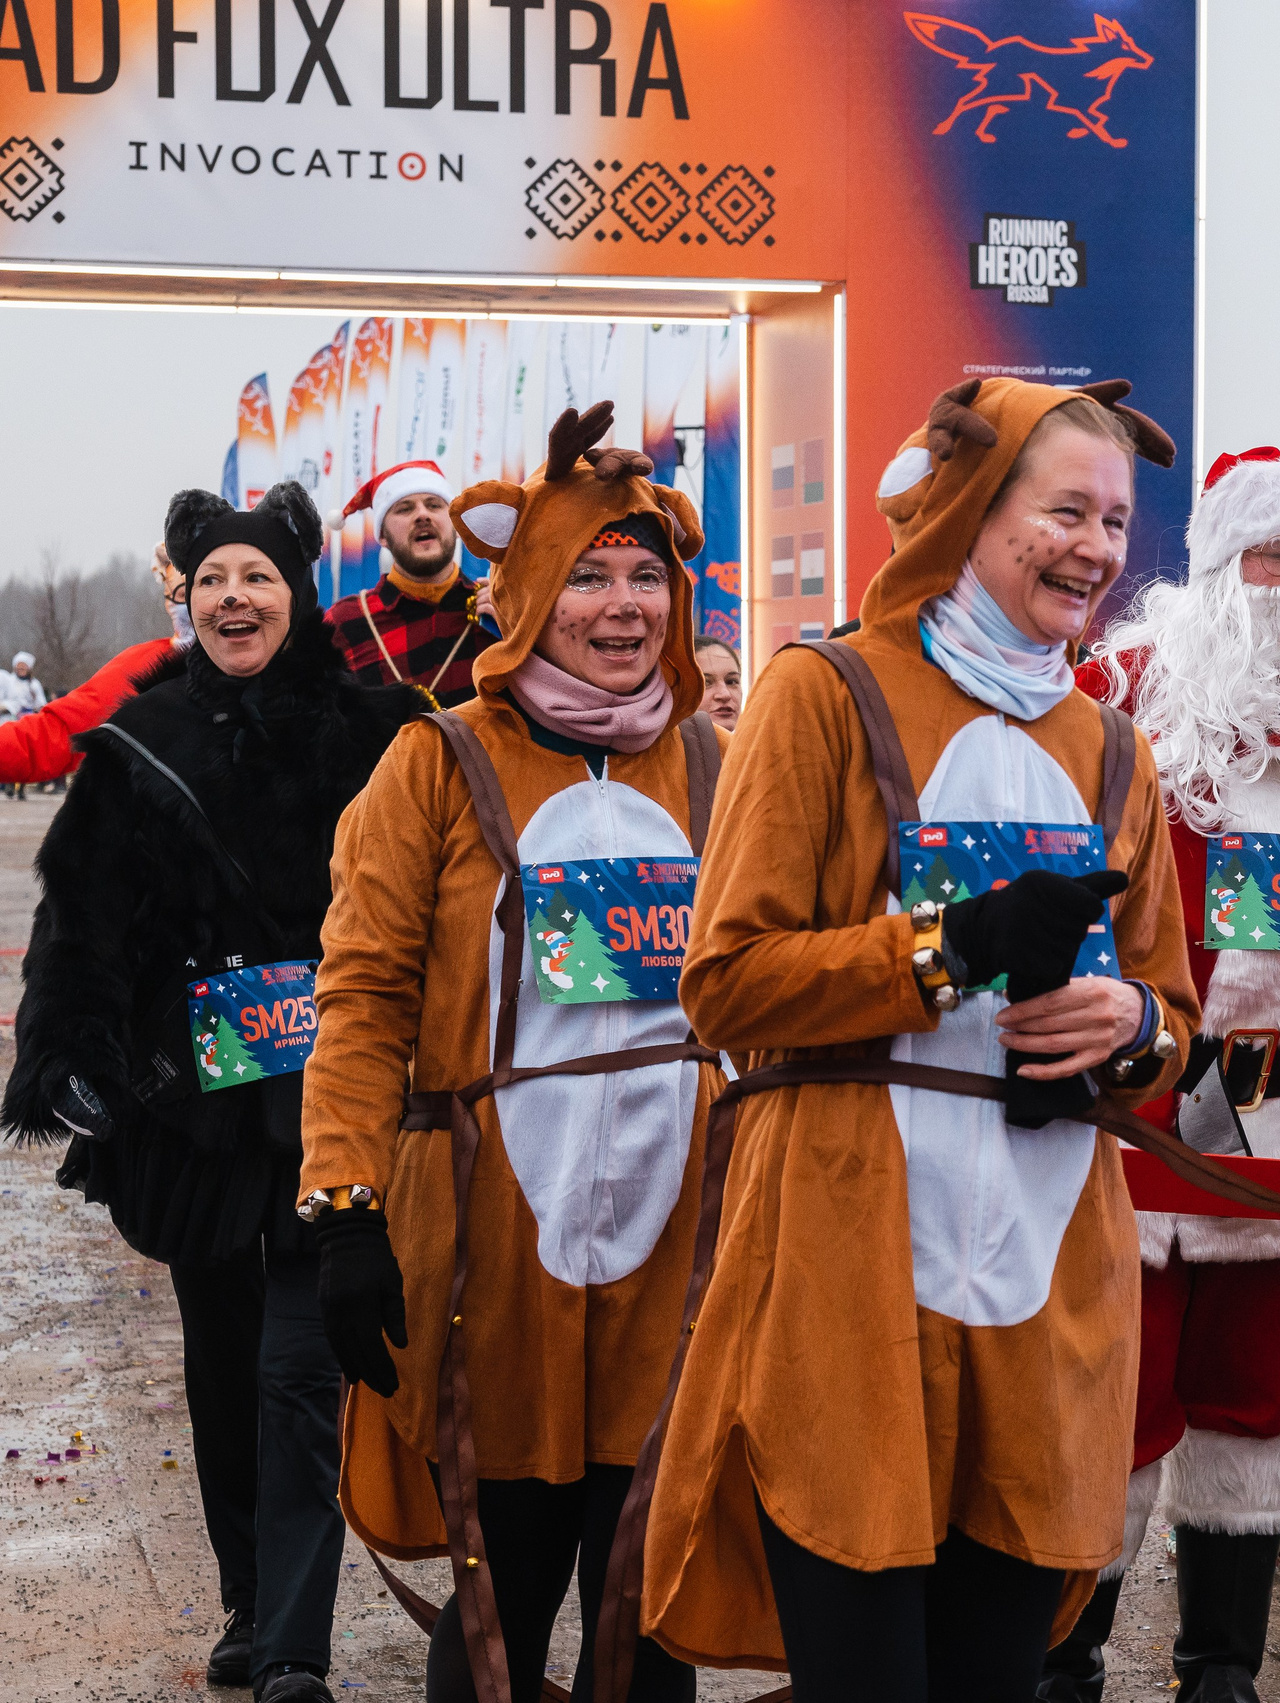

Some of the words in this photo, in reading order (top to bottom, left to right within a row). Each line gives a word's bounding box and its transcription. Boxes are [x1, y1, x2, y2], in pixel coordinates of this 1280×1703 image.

[382, 0, 691, 121] ULTRA
[128, 140, 465, 183] INVOCATION
[988, 217, 1069, 248] RUNNING
[978, 244, 1079, 288] HEROES
[1006, 284, 1049, 304] RUSSIA
[962, 364, 1046, 376] СТРАТЕГИЧЕСКИЙ
[652, 863, 698, 876] SNOWMAN
[274, 964, 312, 977] SNOWMAN
[240, 995, 318, 1042] SM25
[274, 1034, 311, 1050] ИРИНА
